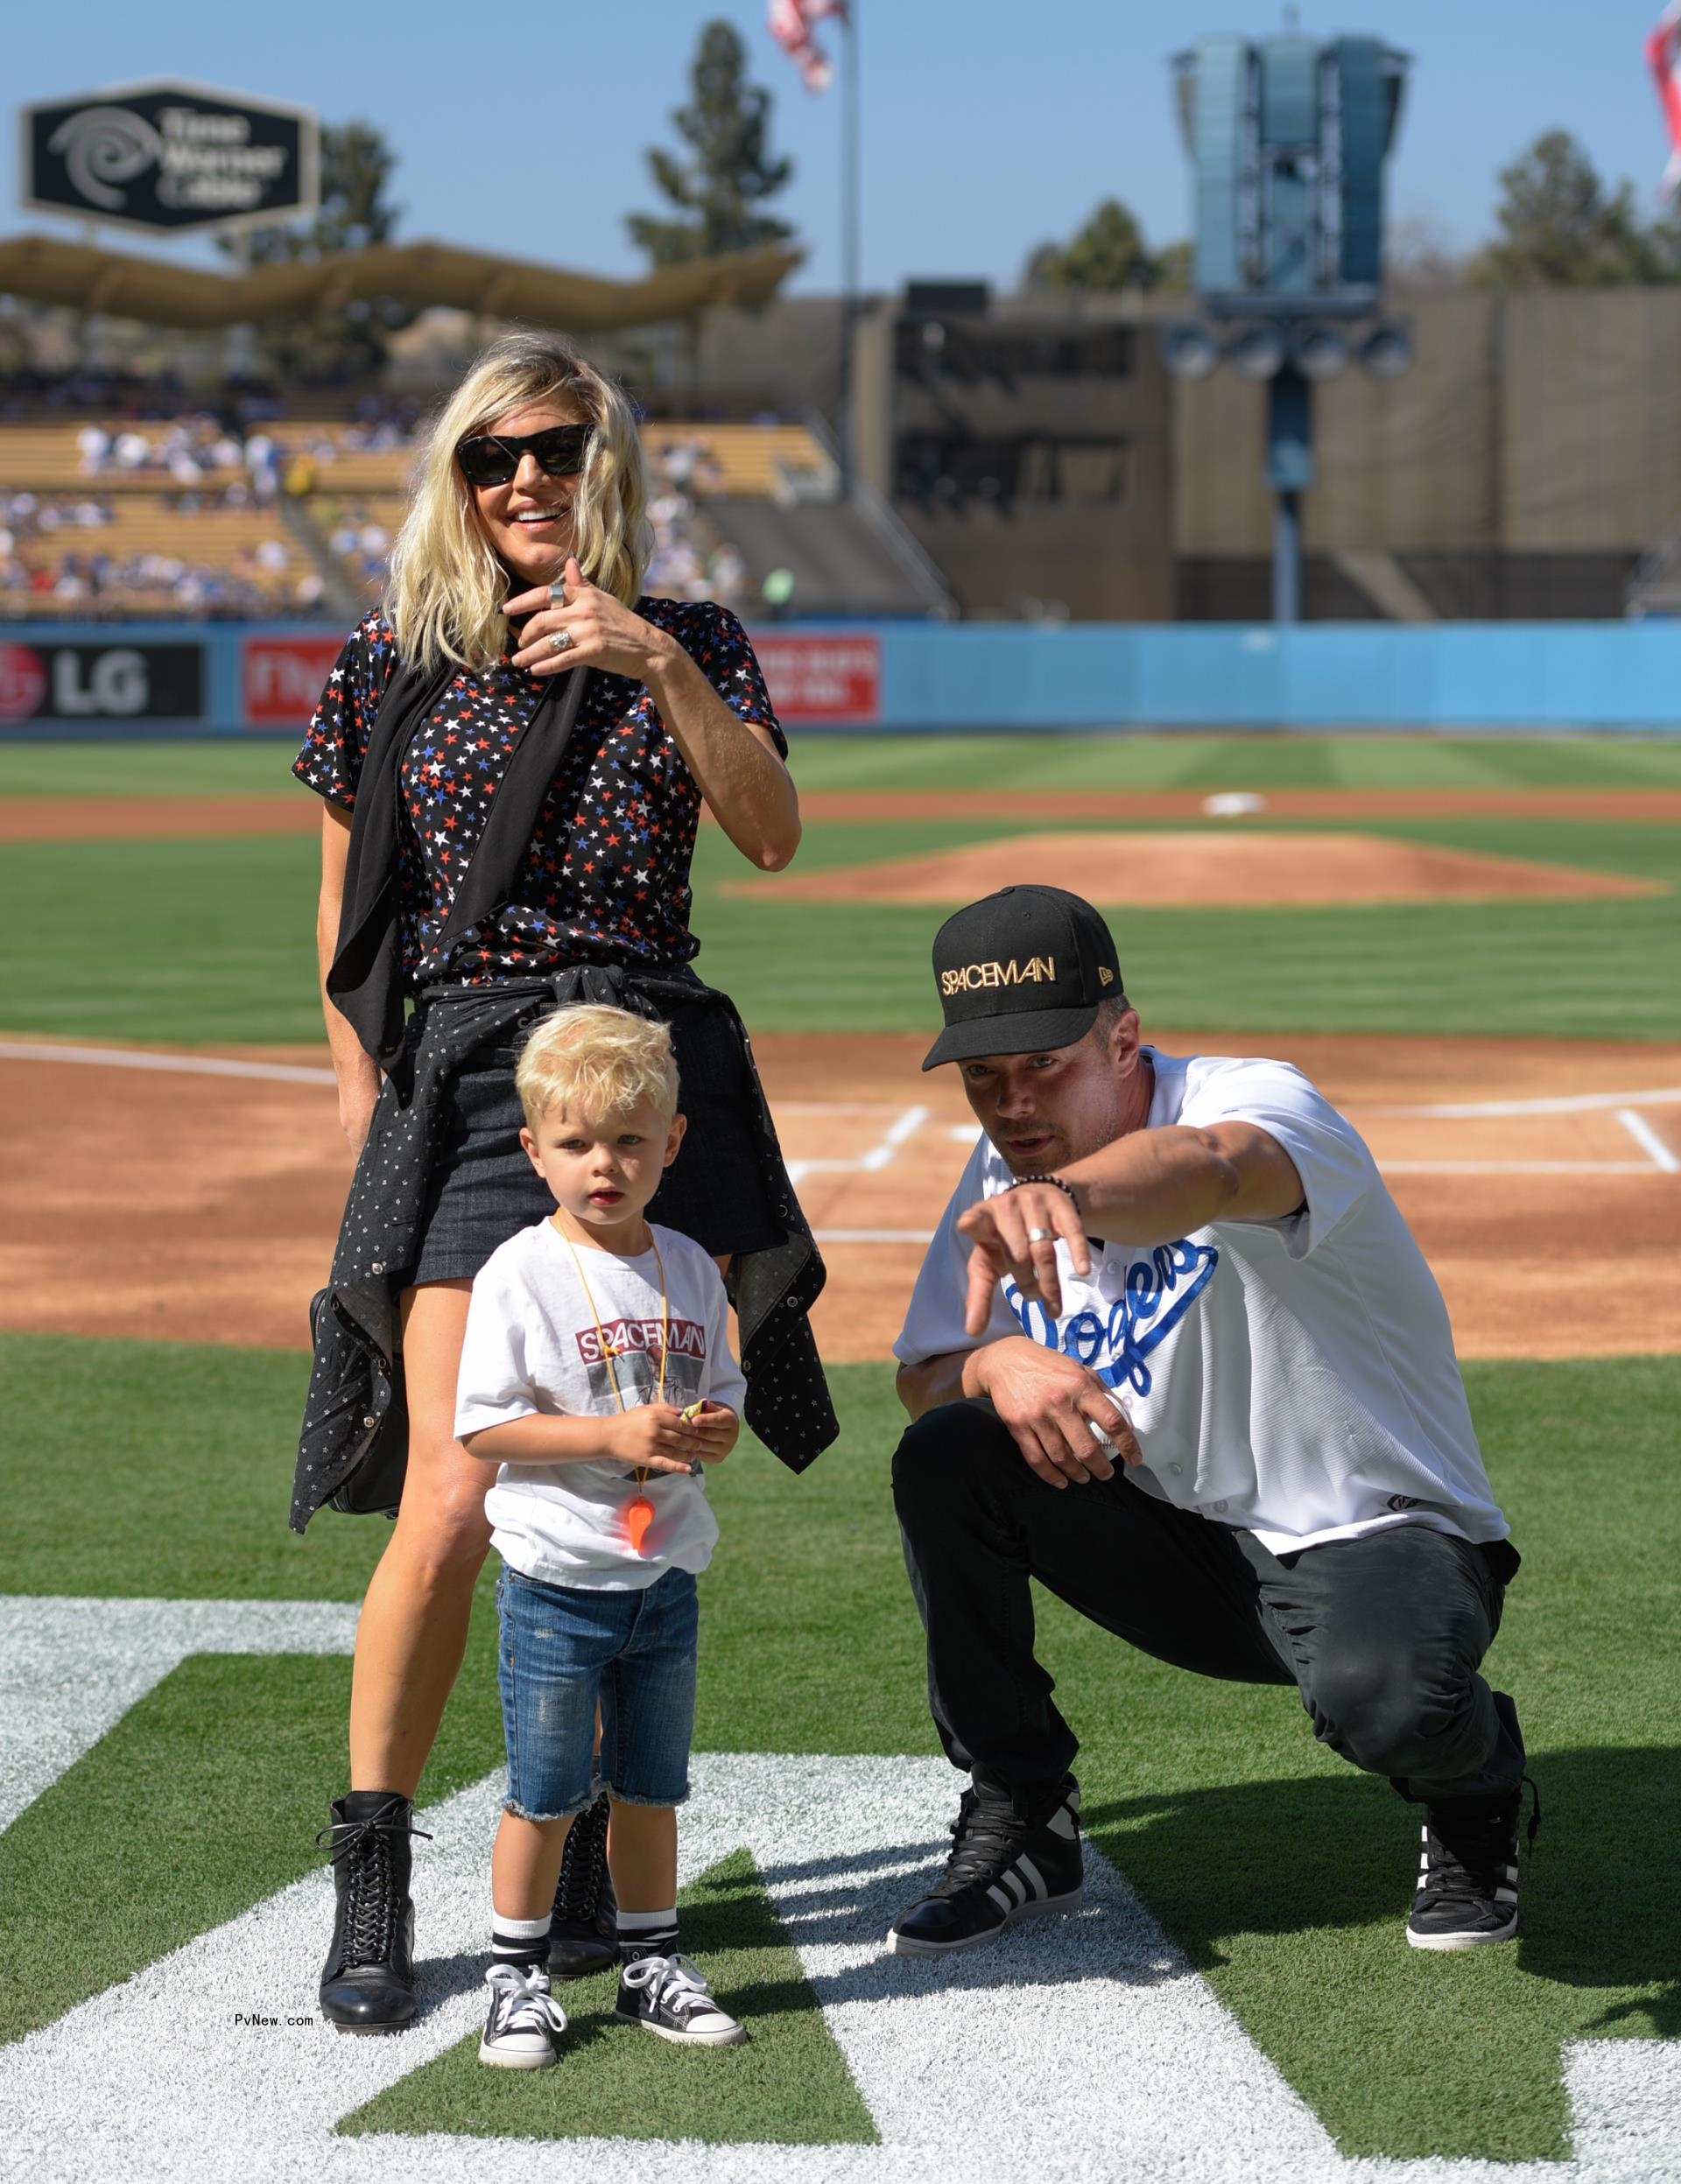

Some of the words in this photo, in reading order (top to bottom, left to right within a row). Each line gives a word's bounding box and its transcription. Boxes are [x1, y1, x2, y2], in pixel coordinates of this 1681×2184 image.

[53, 650, 149, 715] LG
[941, 957, 1056, 996] SPACEMAN
[580, 1322, 705, 1360] SPACEMAN
